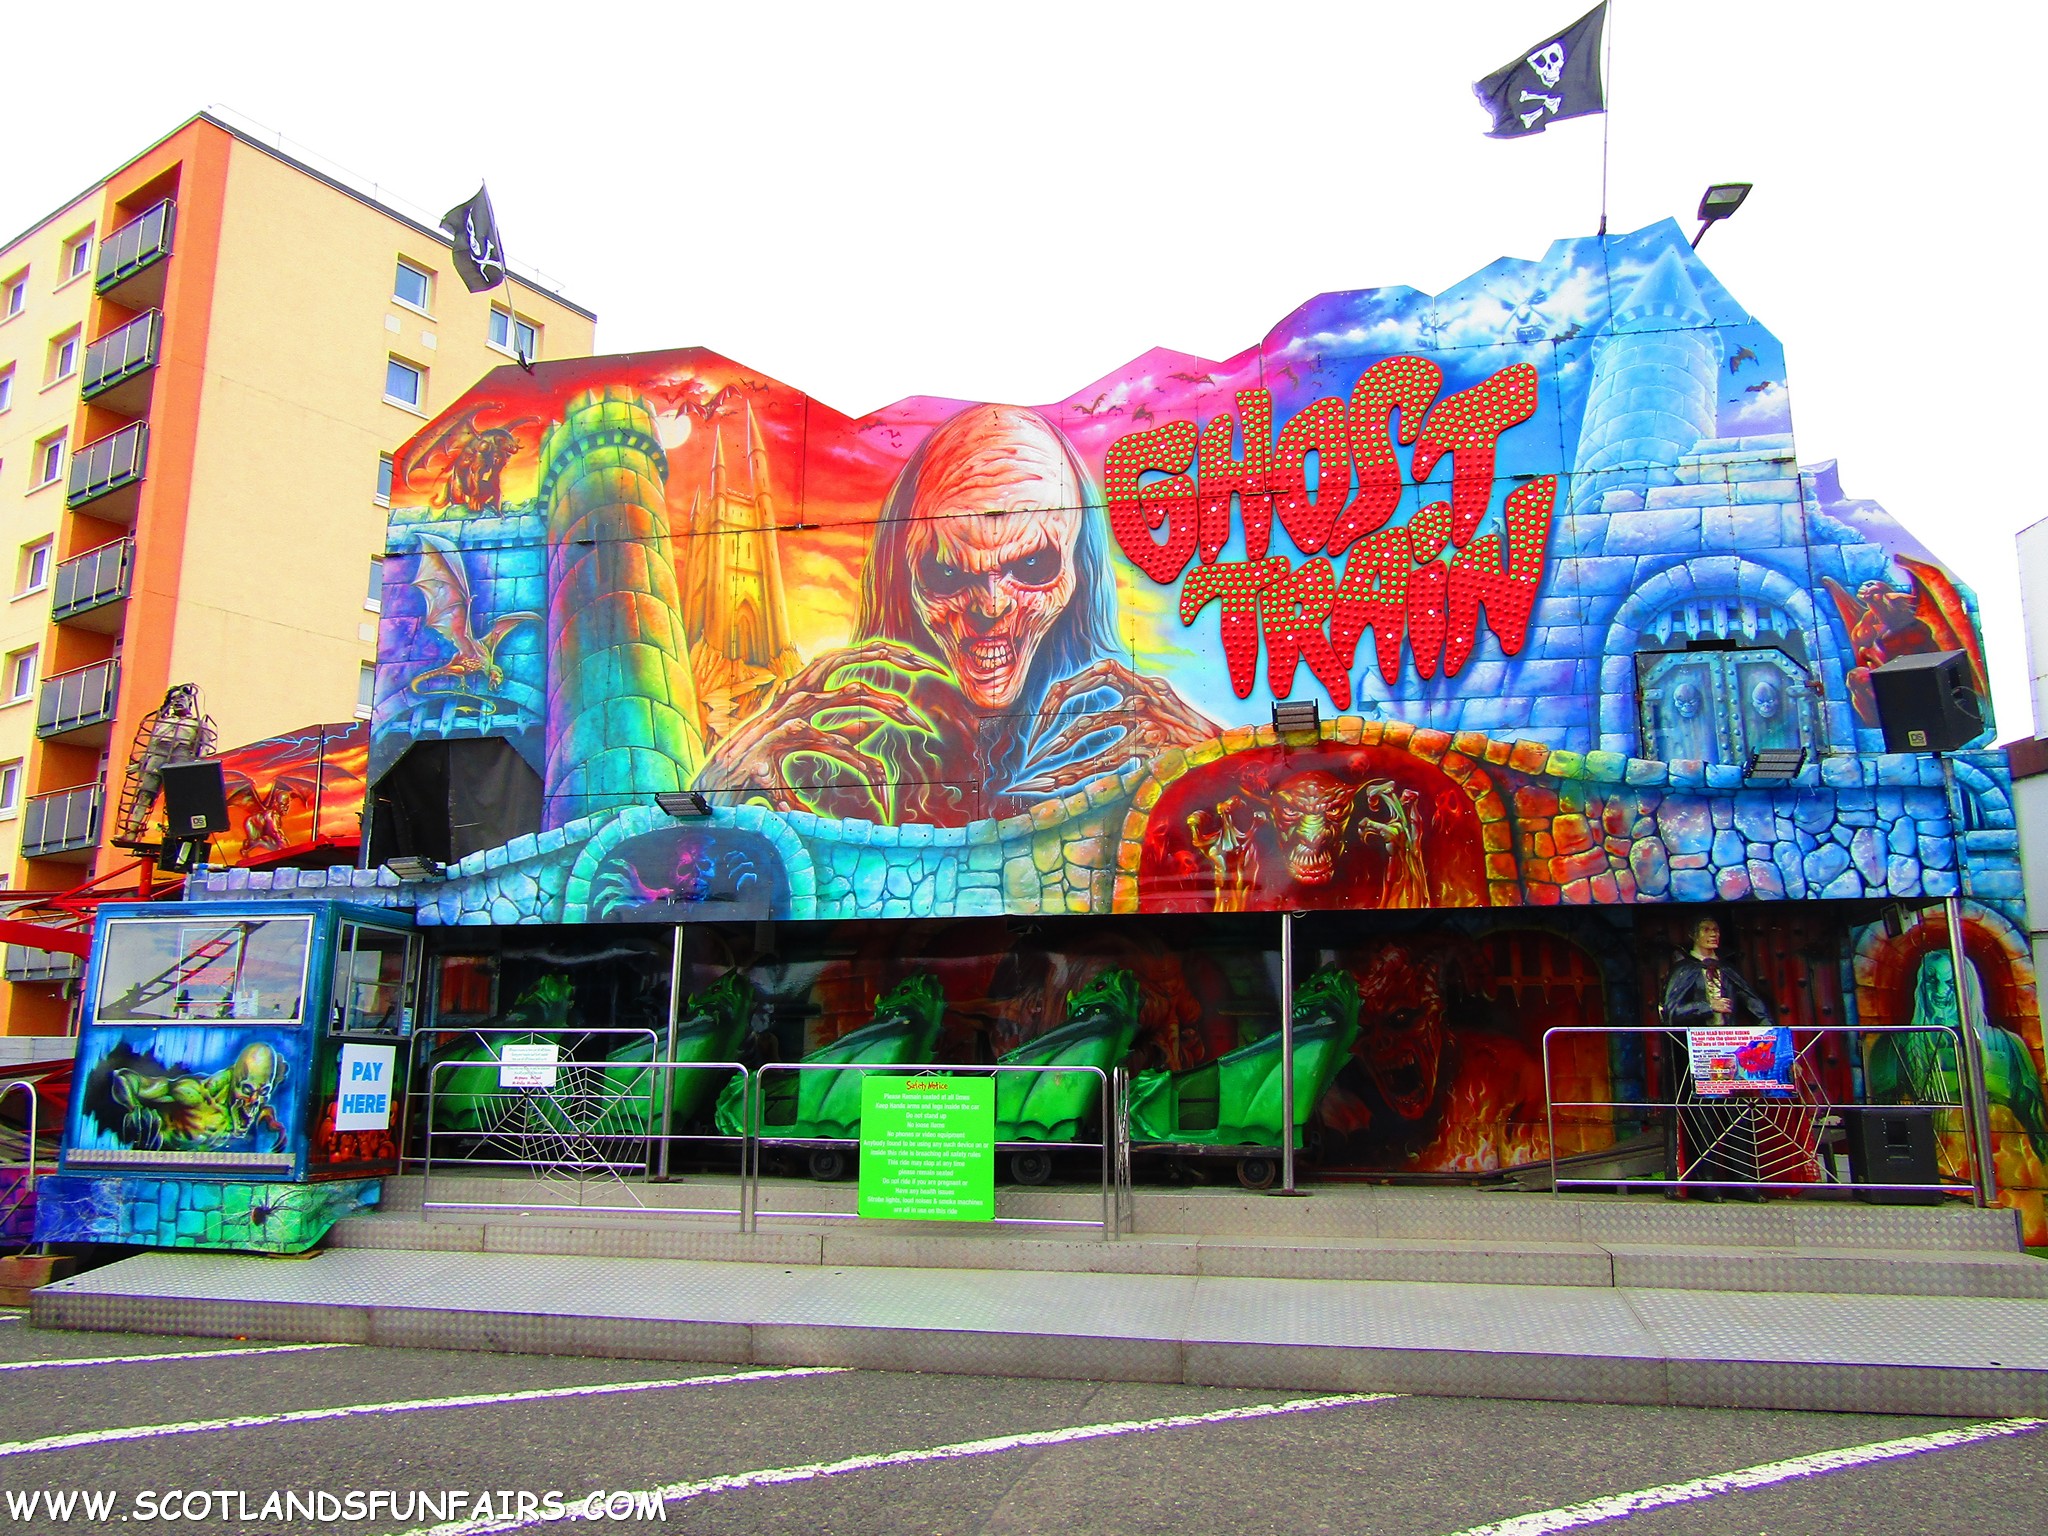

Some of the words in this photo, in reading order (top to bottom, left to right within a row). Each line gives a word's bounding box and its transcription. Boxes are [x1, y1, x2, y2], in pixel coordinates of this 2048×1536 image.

[1105, 355, 1538, 584] GHOST
[1179, 475, 1557, 711] TRAIN
[352, 1062, 384, 1081] PAY
[906, 1081, 926, 1091] Safety
[928, 1082, 948, 1090] Notice
[342, 1094, 386, 1114] HERE
